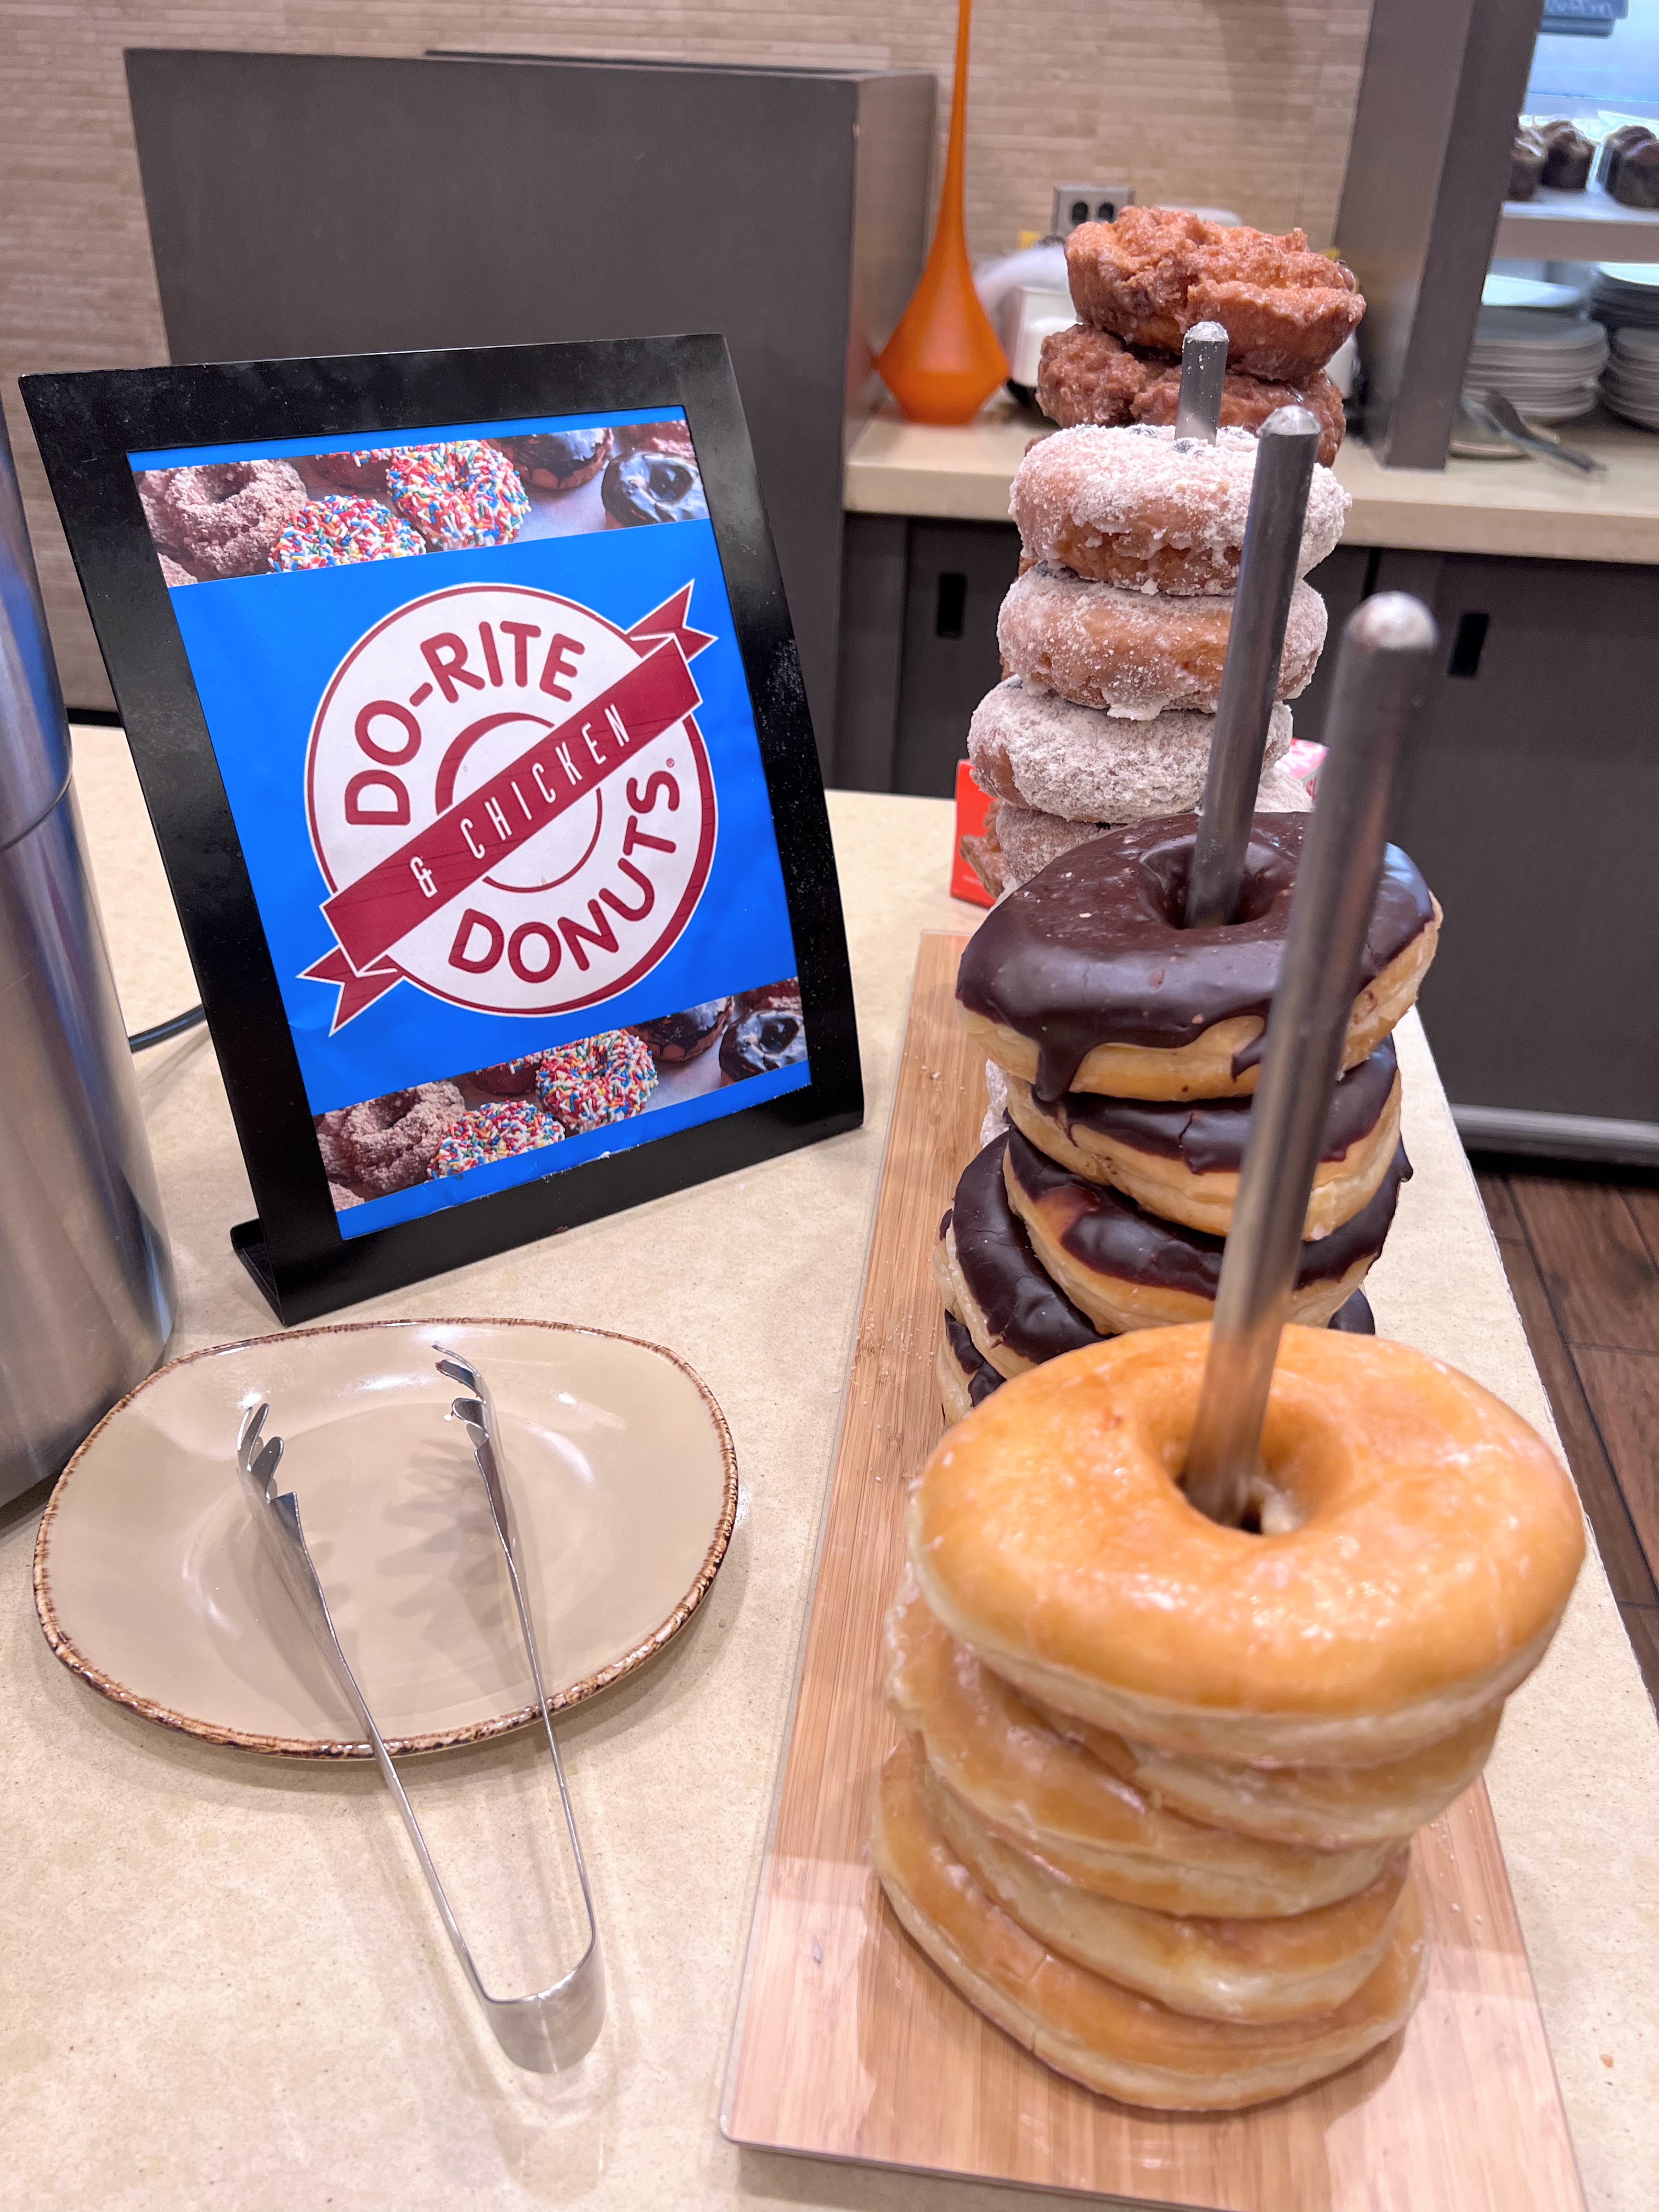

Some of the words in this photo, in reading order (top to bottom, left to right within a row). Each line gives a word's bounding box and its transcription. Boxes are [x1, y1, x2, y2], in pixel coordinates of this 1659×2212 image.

[346, 620, 585, 825] DO-RITE
[410, 856, 437, 897] &
[460, 703, 630, 859] CHICKEN
[449, 770, 680, 983] DONUTS
